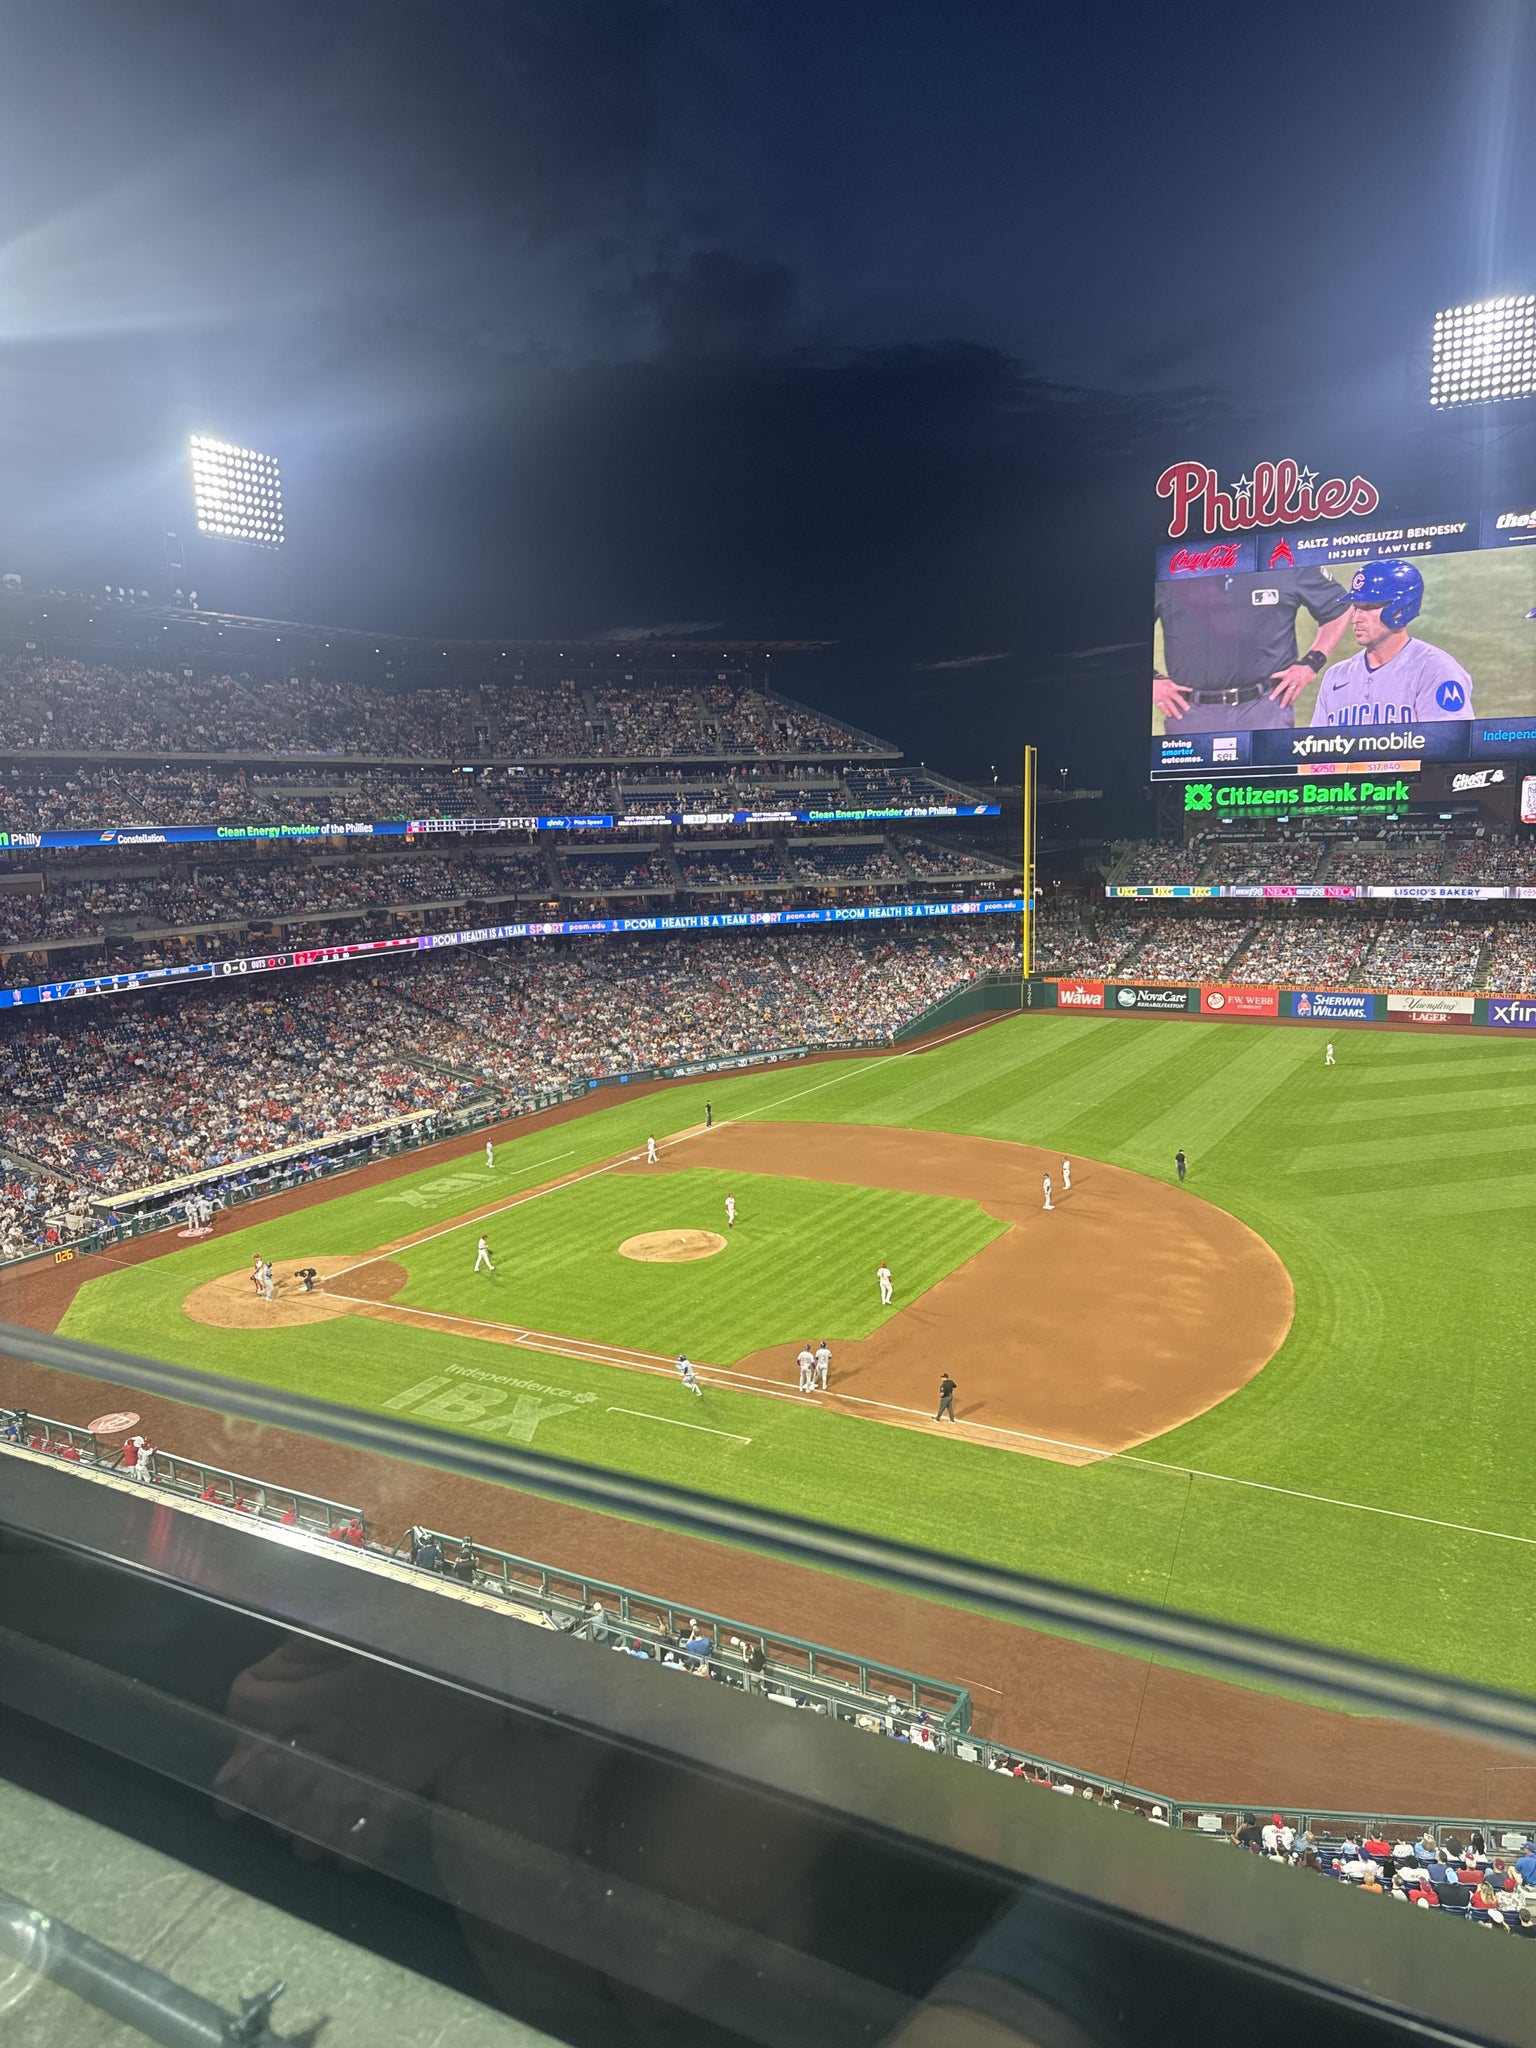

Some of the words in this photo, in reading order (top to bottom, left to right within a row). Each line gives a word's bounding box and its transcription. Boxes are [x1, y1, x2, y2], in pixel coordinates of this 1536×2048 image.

[1156, 458, 1379, 538] Phillies
[1297, 537, 1329, 549] SALTZ
[1332, 530, 1403, 546] MONGELUZZI
[1407, 522, 1466, 538] BENDESKY
[1328, 547, 1370, 559] INJURY
[1378, 541, 1432, 554] LAWYERS
[1162, 740, 1192, 749] Driving
[1292, 735, 1356, 756] xfinity
[1358, 731, 1425, 751] mobile
[1452, 769, 1494, 791] GHOST
[1216, 786, 1299, 806] Citizens
[1303, 782, 1357, 803] Bank
[1360, 780, 1410, 801] Park
[809, 811, 834, 819] Clean
[835, 810, 865, 820] Energy
[867, 808, 903, 817] Provider
[904, 808, 914, 816] of
[914, 807, 927, 816] the
[929, 806, 957, 815] Phillies
[217, 826, 245, 837] Clean
[247, 826, 280, 838] Energy
[281, 824, 319, 835] Provider
[321, 824, 331, 834] of
[331, 824, 344, 834] the
[346, 823, 373, 833] Phillies
[11, 833, 41, 847] Philly
[1117, 887, 1138, 897] UKG
[1153, 887, 1174, 896] UKG
[1190, 887, 1211, 896] UKG
[1266, 887, 1292, 896] NECA
[1327, 887, 1355, 896] NECA
[1394, 888, 1436, 896] LISCIO'S
[1439, 888, 1481, 896] BAKERY
[835, 909, 865, 919] PCOM
[869, 907, 900, 917] HEALTH
[905, 906, 913, 915] IS
[916, 905, 922, 915] A
[924, 904, 948, 915] TEAM
[984, 901, 1016, 910] pcom.edu
[624, 920, 655, 930] PCOM
[661, 917, 697, 928] HEALTH
[700, 916, 709, 926] IS
[712, 916, 719, 925] A
[721, 914, 747, 925] TEAM
[786, 911, 820, 920] pcom.edu
[432, 934, 458, 946] PCOM
[460, 931, 487, 942] HEALTH
[489, 928, 496, 938] IS
[498, 927, 504, 937] A
[505, 925, 526, 936] TEAM
[569, 922, 606, 932] pcom.edu
[1061, 991, 1102, 1005] Wawa
[1137, 990, 1187, 1002] NovaCare
[1245, 996, 1273, 1005] WEBB
[1314, 994, 1365, 1006] SHERWIN
[1404, 997, 1457, 1011] Yuengling
[1412, 1013, 1447, 1021] LAGER
[445, 1363, 572, 1398] Independence
[380, 1375, 580, 1442] IBX
